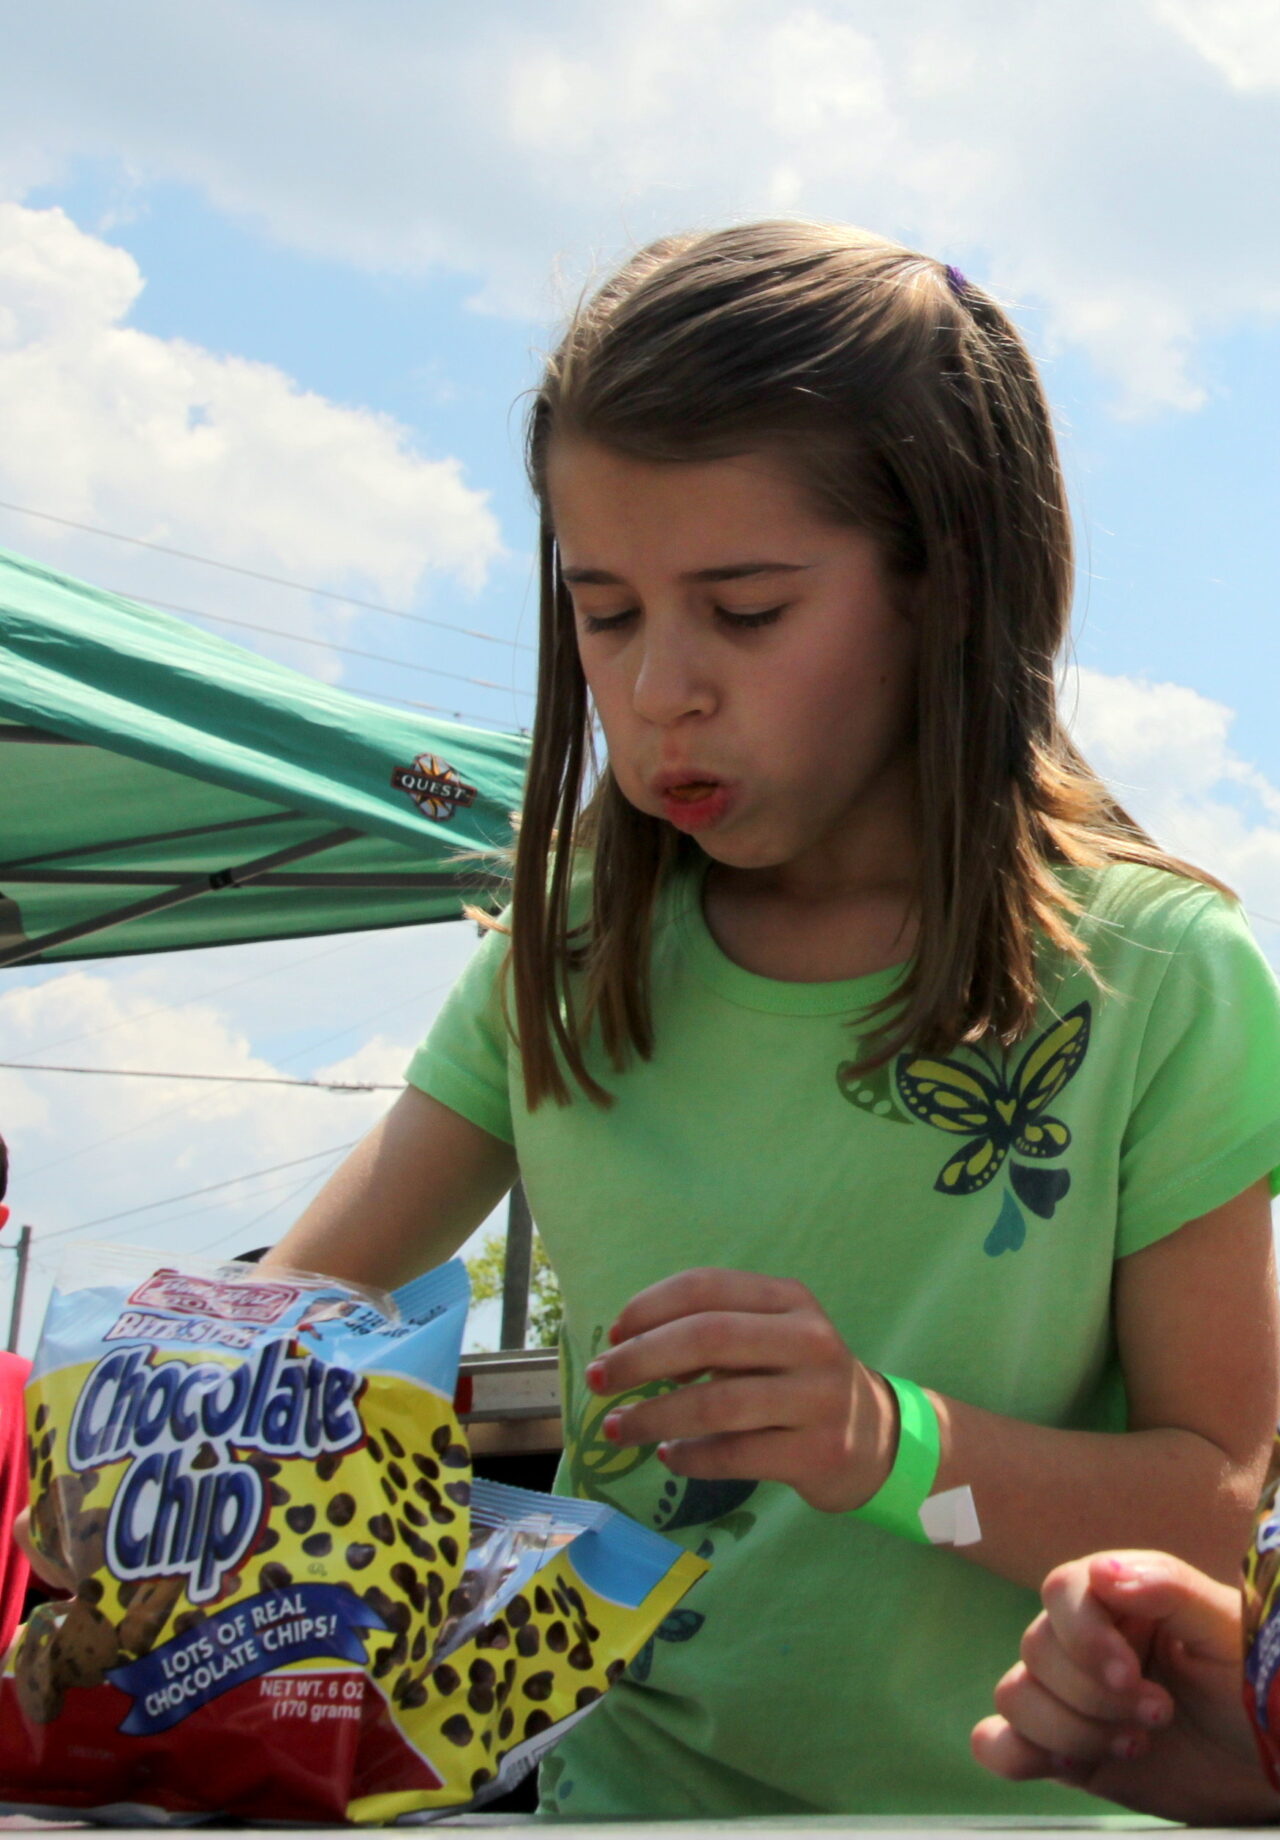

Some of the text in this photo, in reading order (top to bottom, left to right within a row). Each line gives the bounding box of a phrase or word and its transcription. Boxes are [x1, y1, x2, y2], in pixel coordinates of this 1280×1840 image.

[401, 774, 467, 800] QUEST
[69, 1337, 367, 1471] Chocolate
[106, 1447, 264, 1604] Chip
[144, 1614, 337, 1716] CHOCOLATE CHIPS!
[161, 1593, 307, 1679] LOTS OF REAL
[259, 1680, 294, 1697] NET
[296, 1681, 324, 1698] WT.
[328, 1681, 338, 1698] 6
[272, 1701, 307, 1720] (170
